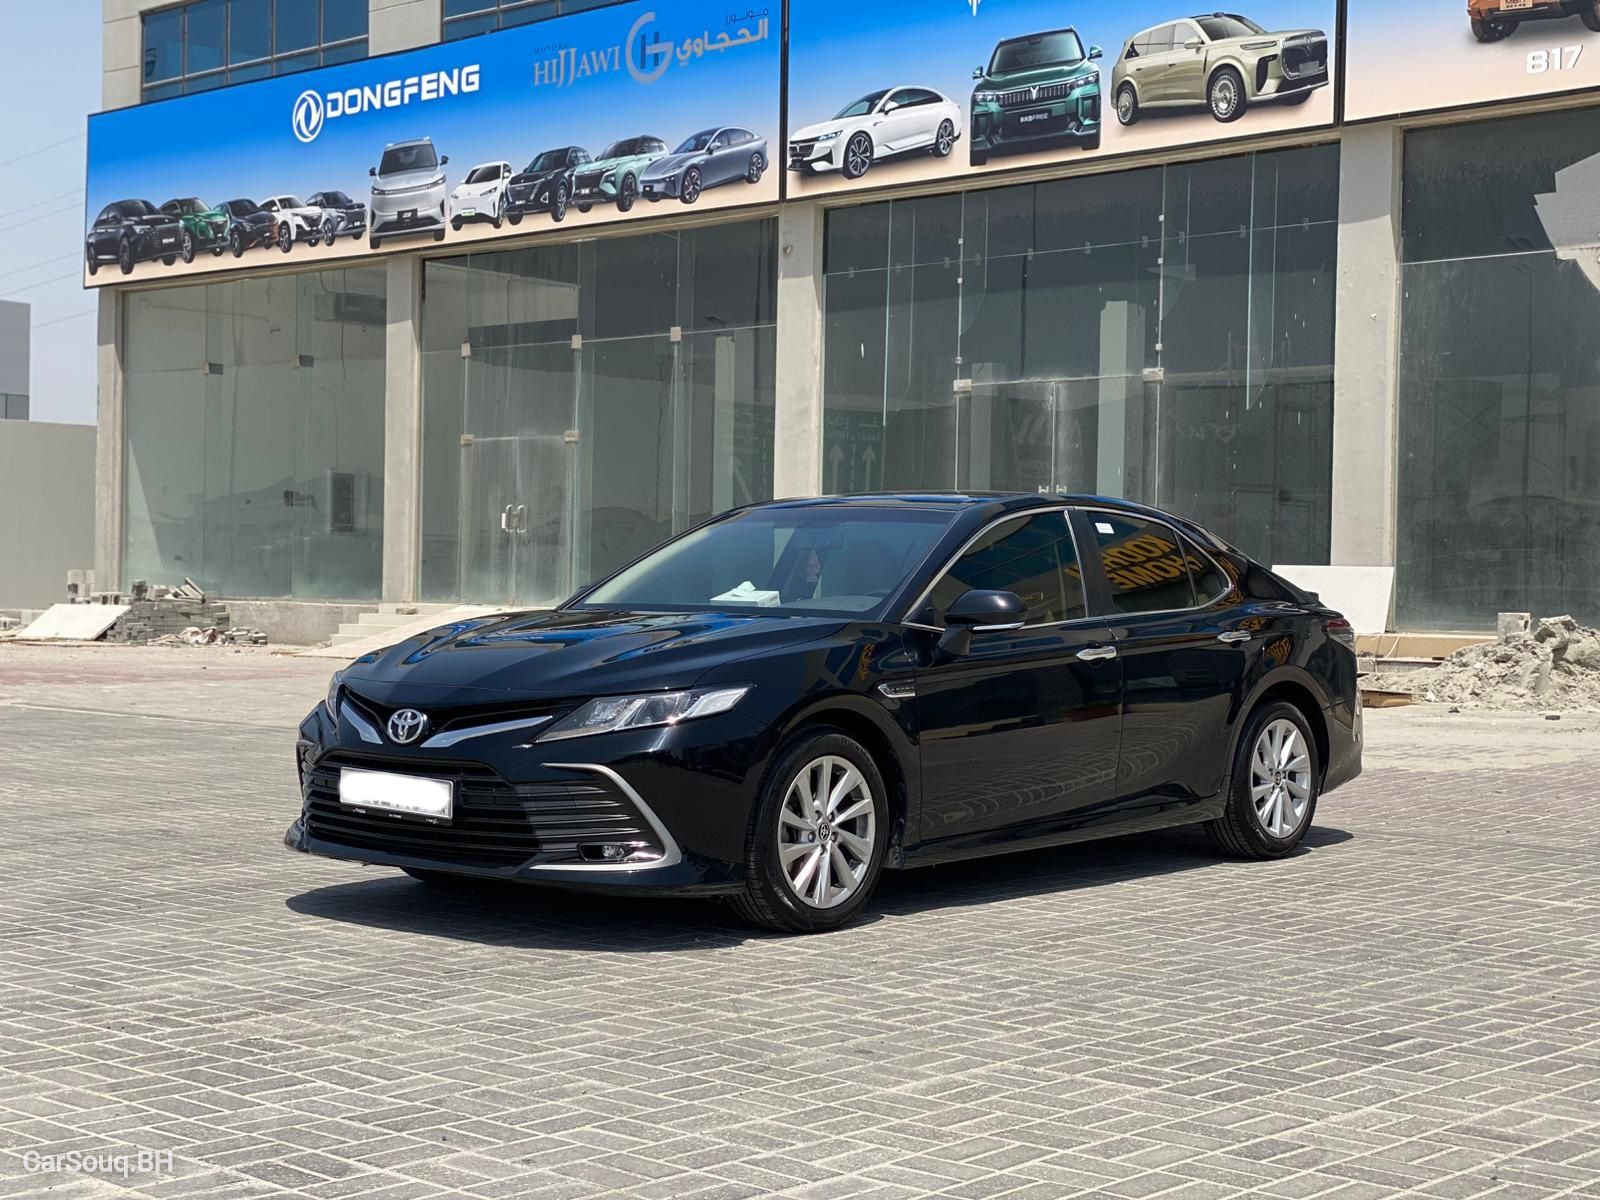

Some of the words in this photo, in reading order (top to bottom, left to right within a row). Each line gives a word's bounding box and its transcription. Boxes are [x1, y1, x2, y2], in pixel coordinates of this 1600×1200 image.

[676, 18, 768, 66] الحجاوي
[1526, 44, 1583, 74] 817
[533, 46, 620, 87] HIJJAWI
[326, 64, 480, 118] DONGFENG
